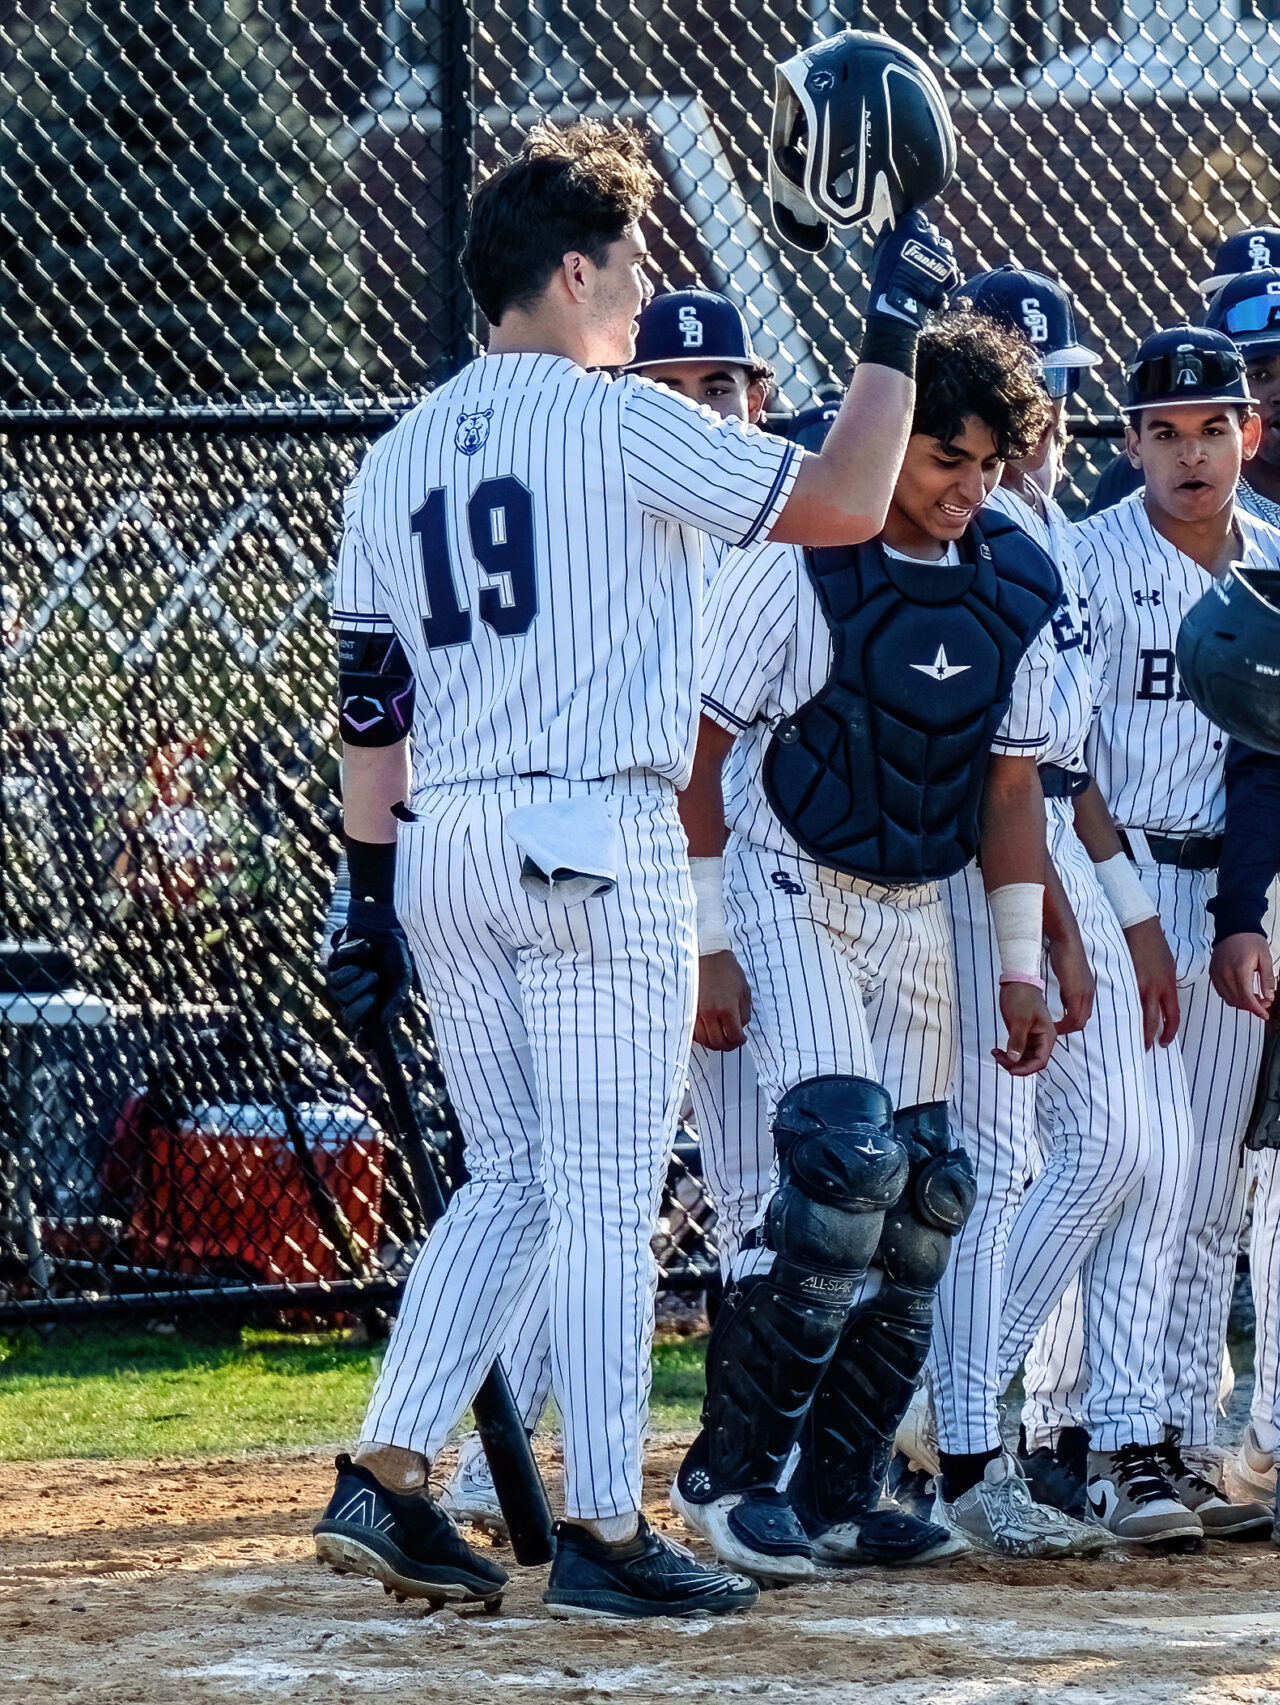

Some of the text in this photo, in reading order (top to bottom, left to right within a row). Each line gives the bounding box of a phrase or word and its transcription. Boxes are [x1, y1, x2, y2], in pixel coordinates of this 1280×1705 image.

[903, 244, 948, 278] Franklin
[678, 306, 703, 348] SB
[409, 473, 541, 651] 19
[800, 1276, 853, 1293] ALL-STAR
